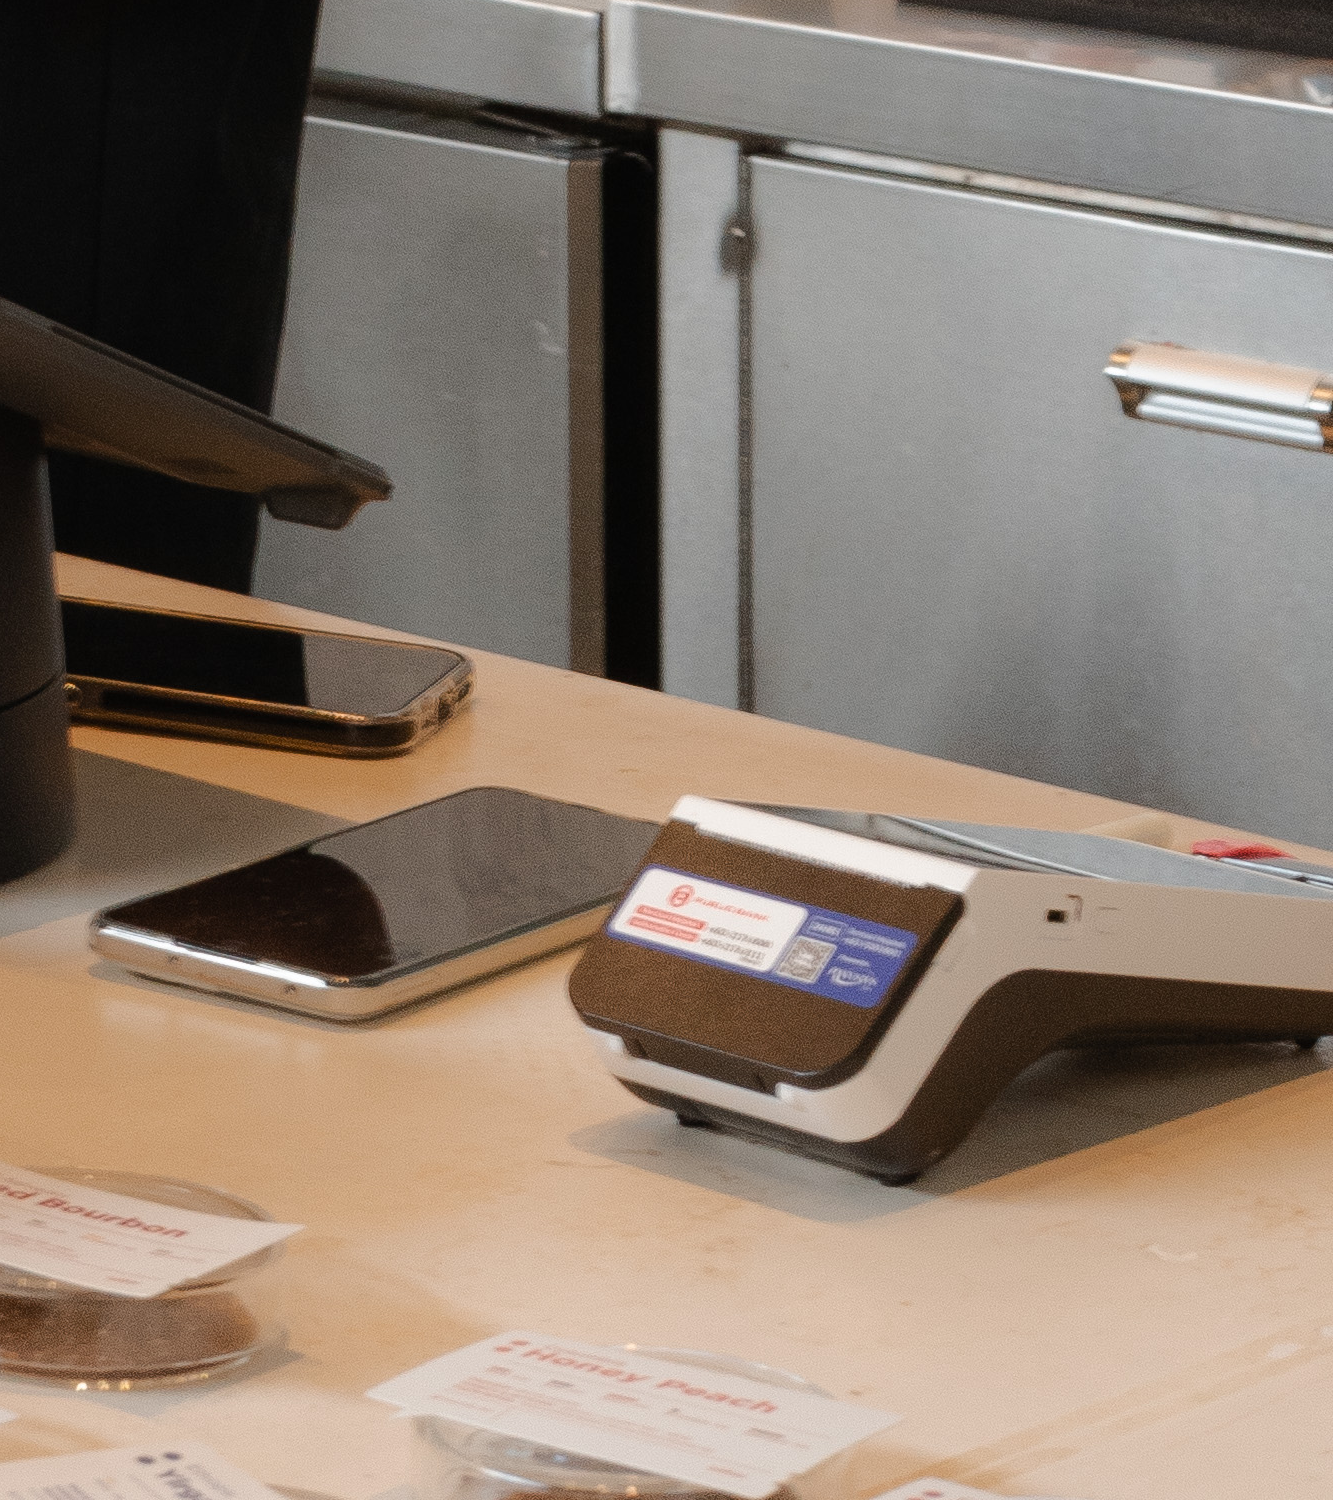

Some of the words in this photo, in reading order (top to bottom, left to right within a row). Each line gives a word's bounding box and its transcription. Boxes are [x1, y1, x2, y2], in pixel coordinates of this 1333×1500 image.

[35, 1195, 191, 1240] Bourbon
[521, 1345, 652, 1385] Honey
[656, 1376, 780, 1416] Peach
